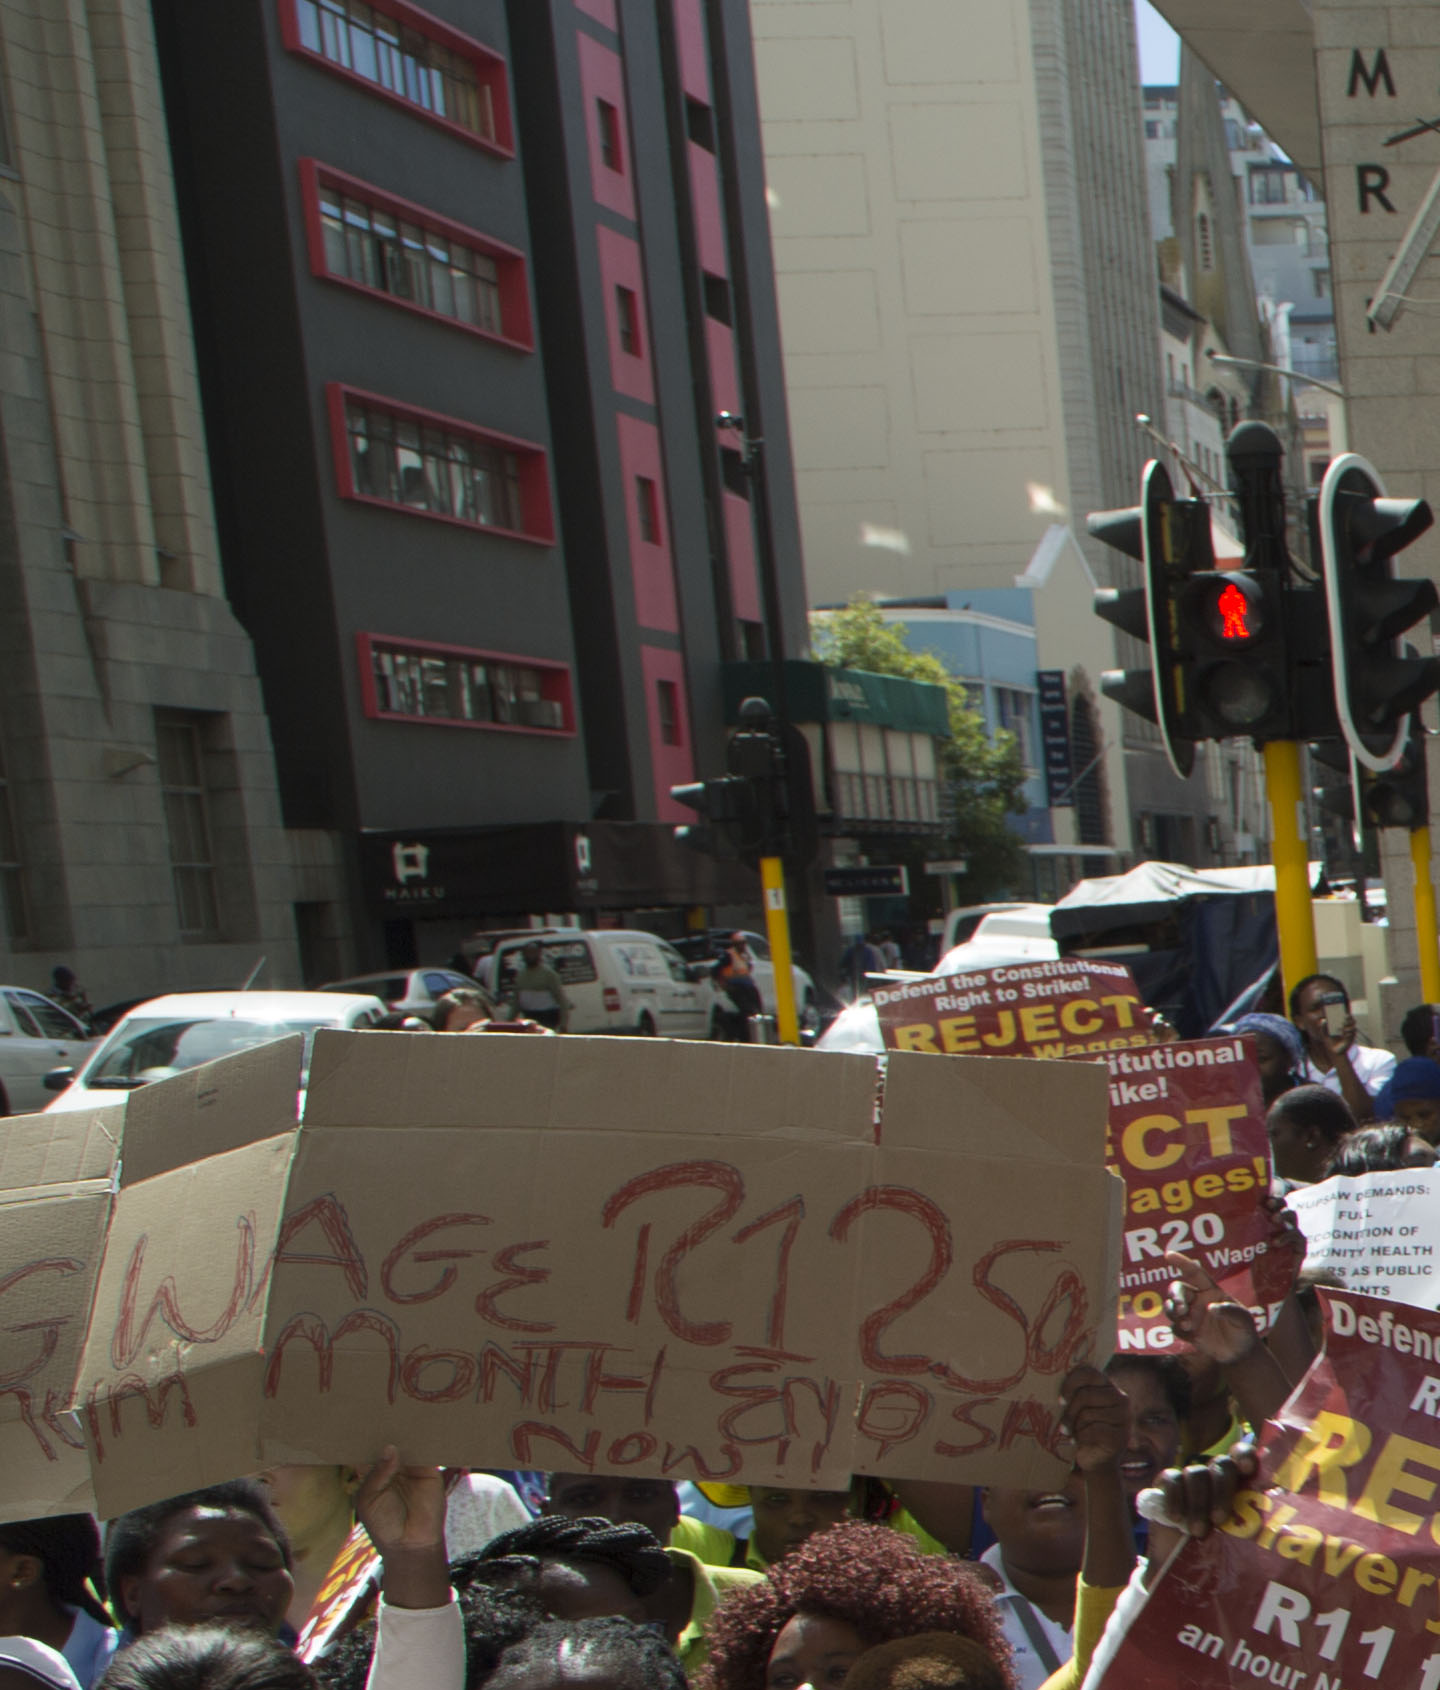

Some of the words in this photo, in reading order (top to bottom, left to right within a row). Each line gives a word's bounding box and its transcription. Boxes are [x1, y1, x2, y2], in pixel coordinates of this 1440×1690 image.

[384, 886, 446, 899] HAIKU
[873, 979, 948, 1007] Defend
[952, 971, 987, 991] the
[991, 960, 1129, 984] Constitutional
[934, 989, 992, 1014] Right
[996, 986, 1018, 1004] to
[1022, 975, 1091, 998] Strike!
[894, 995, 1139, 1055] REJECT
[1110, 1041, 1244, 1075] itutional
[1111, 1076, 1169, 1106] ike!
[1129, 1156, 1269, 1214] ages!
[1355, 1184, 1432, 1203] DEMANDS:
[1125, 1212, 1225, 1263] R20
[1371, 1244, 1433, 1258] HEALTH
[1398, 1225, 1420, 1239] OF
[1207, 1239, 1268, 1271] Wage
[1375, 1264, 1433, 1277] PUBLIC
[111, 1191, 558, 1371] WAGE
[264, 1308, 668, 1427] MONTH
[1176, 1619, 1224, 1658] an
[1251, 1580, 1399, 1682] R11
